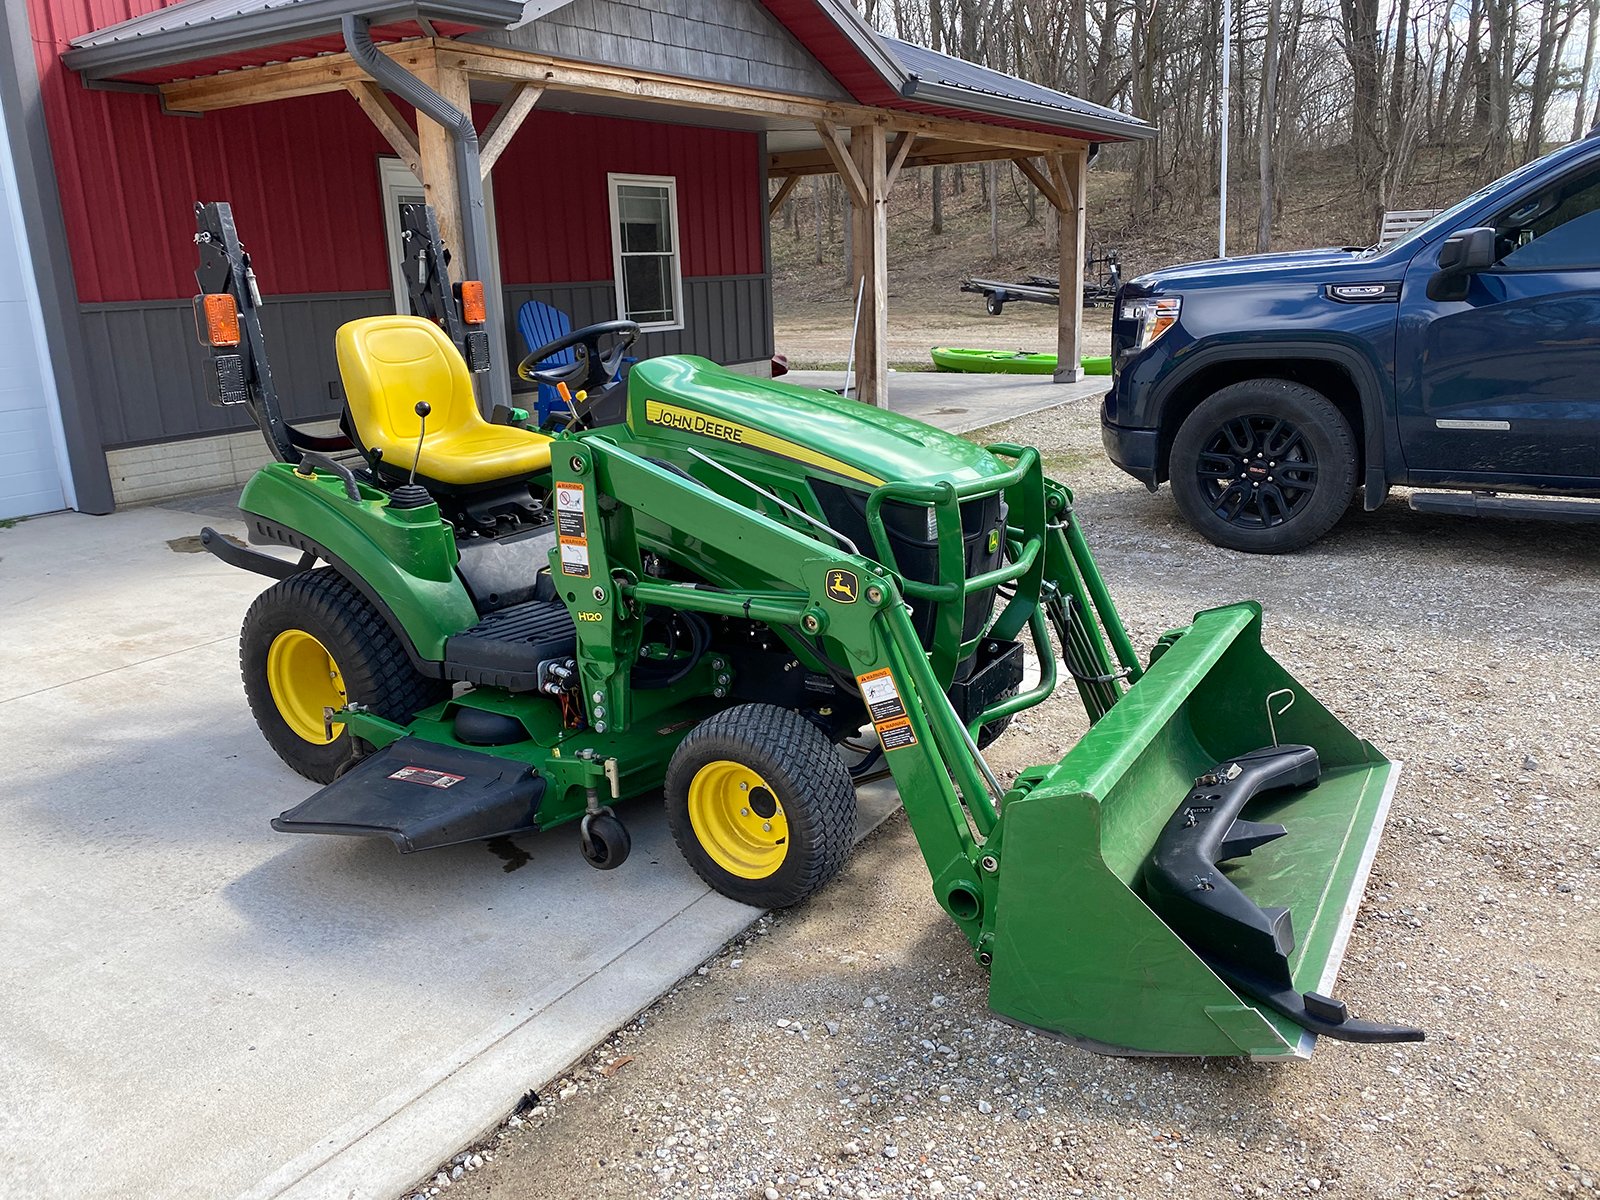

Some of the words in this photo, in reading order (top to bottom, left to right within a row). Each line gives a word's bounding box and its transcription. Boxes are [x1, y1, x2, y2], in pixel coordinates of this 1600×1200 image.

[655, 409, 693, 429] JOHN
[694, 416, 743, 442] DEERE
[578, 611, 603, 622] H120
